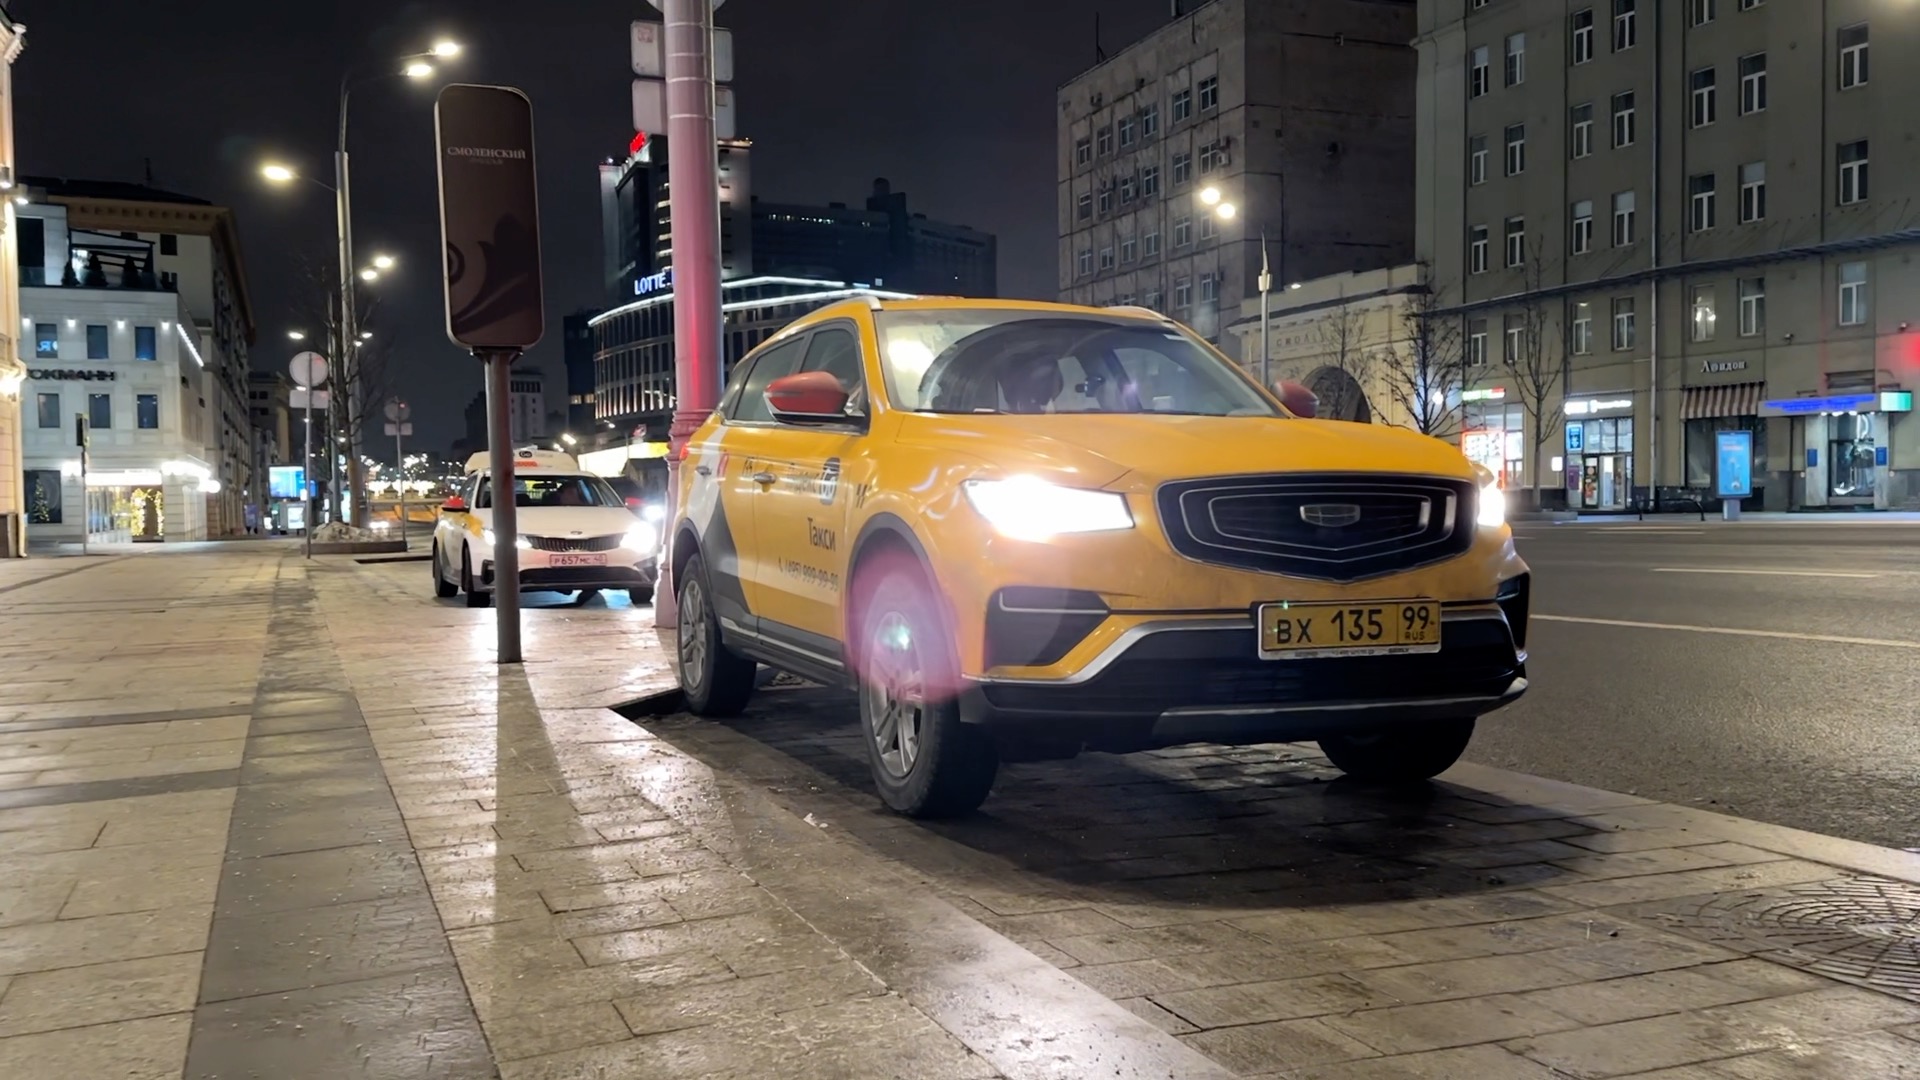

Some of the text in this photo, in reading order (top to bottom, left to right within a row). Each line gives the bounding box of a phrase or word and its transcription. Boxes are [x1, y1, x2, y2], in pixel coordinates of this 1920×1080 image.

[447, 146, 526, 159] СМОЛЕНСКИЙ
[634, 272, 666, 295] LOTTE
[808, 517, 836, 552] Такси
[1331, 609, 1383, 641] 135
[1402, 606, 1430, 630] 99
[1405, 631, 1425, 641] RUS
